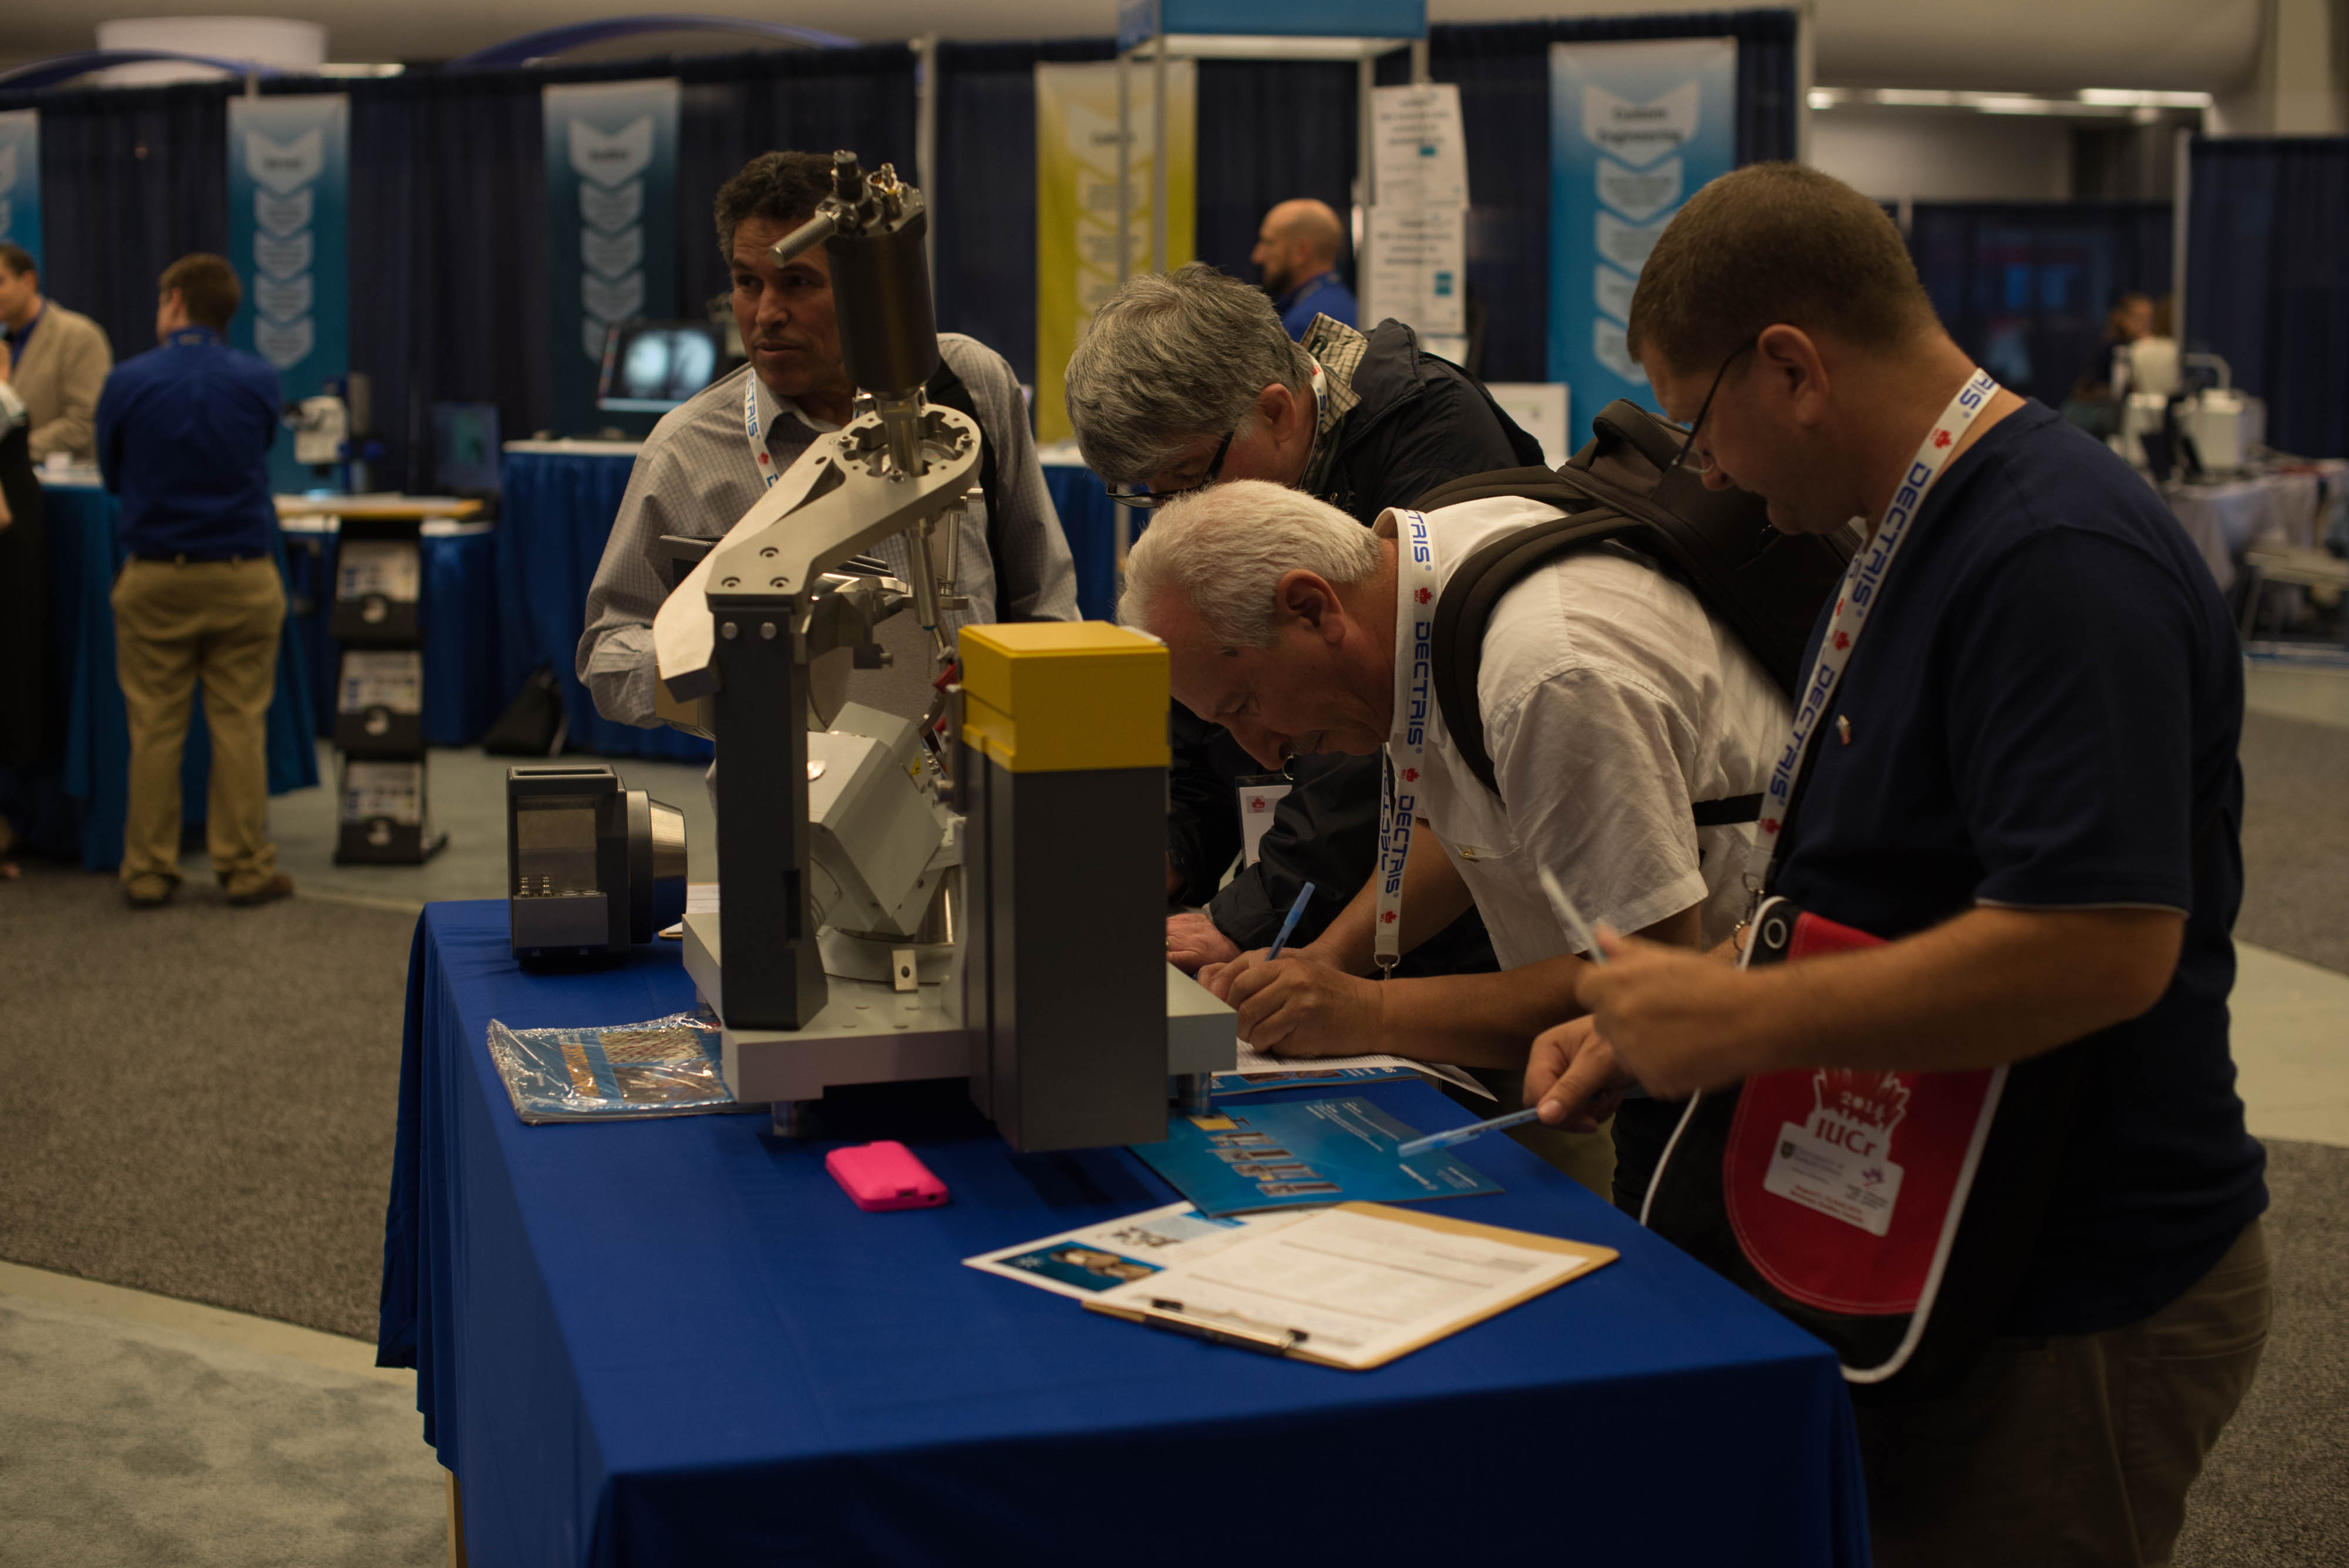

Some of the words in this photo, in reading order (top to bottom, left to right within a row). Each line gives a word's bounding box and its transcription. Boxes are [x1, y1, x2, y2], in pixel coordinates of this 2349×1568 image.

[746, 371, 758, 436] ECTRIS
[1853, 462, 1930, 607] DECTRIS
[1407, 621, 1431, 745] DECTRIS
[1771, 664, 1835, 798] DECTRIS
[1385, 795, 1414, 894] DECTRIS
[1816, 1118, 1877, 1156] IUCr
